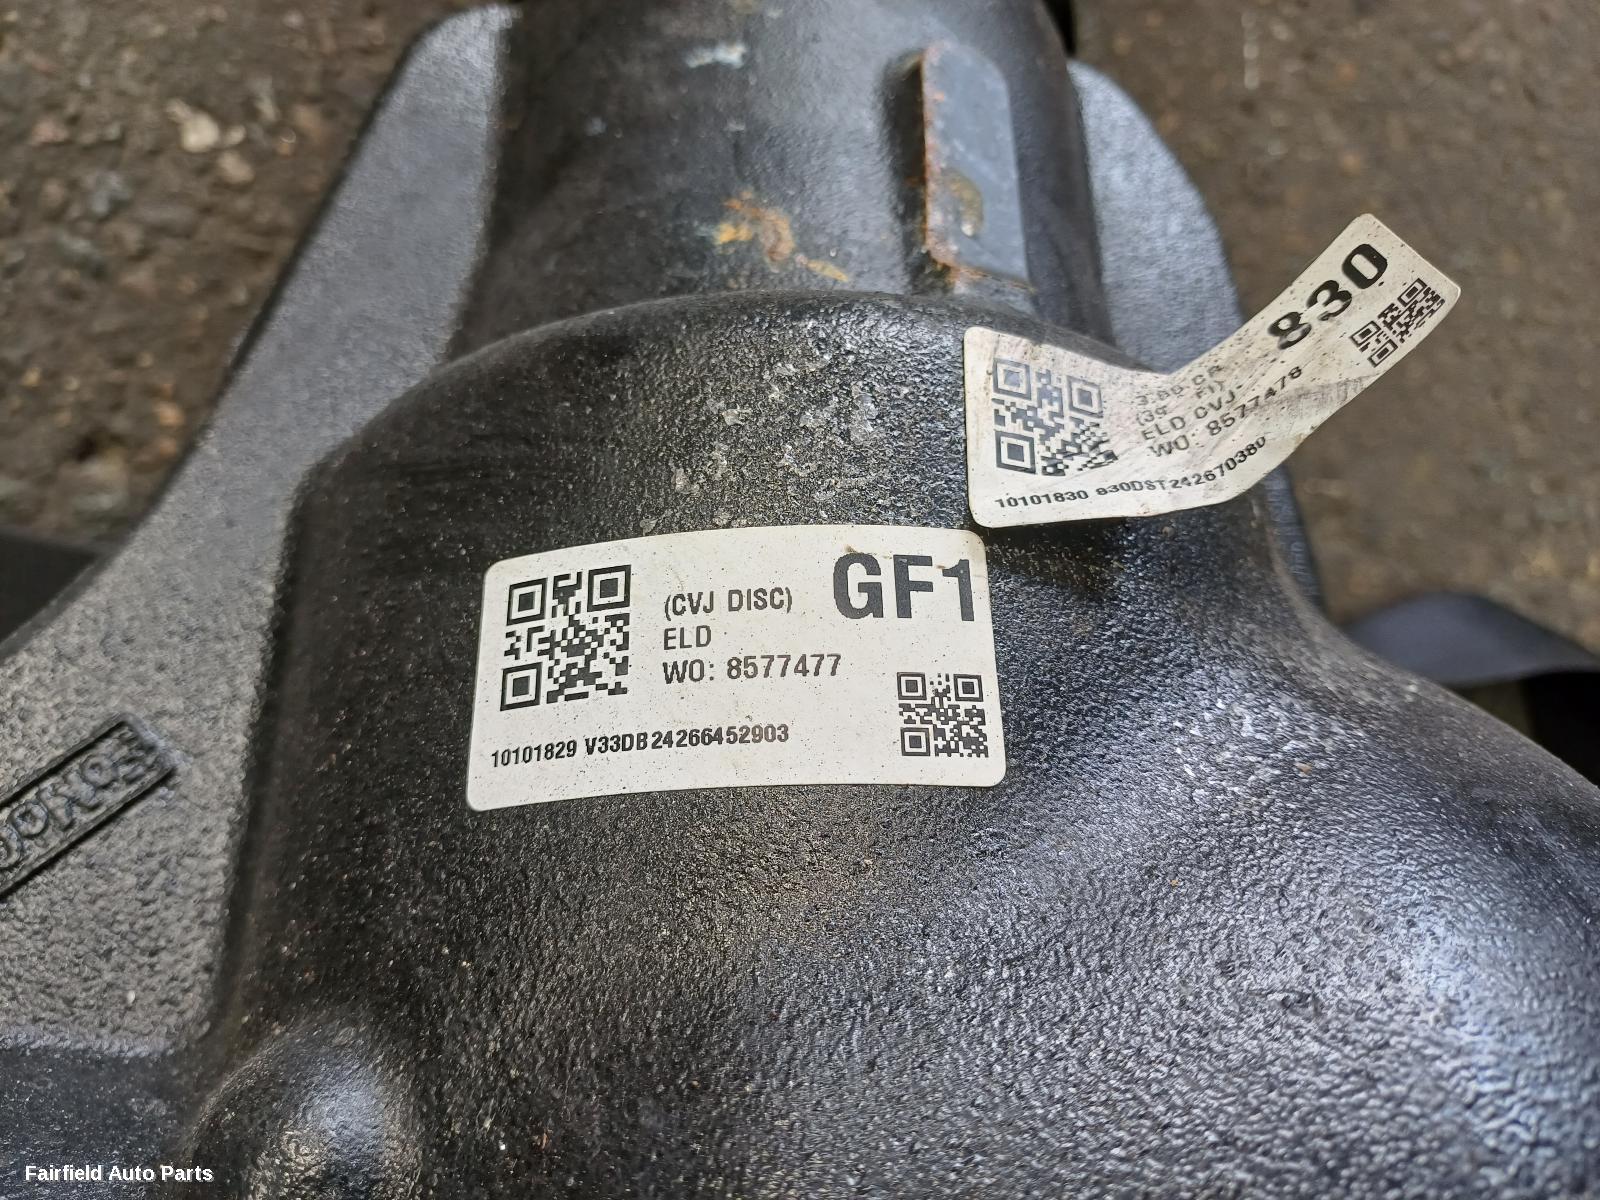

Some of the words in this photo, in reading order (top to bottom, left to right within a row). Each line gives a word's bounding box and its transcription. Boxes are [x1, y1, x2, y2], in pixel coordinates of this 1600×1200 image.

[1268, 242, 1388, 351] 830
[1206, 365, 1303, 437] 8577478
[1141, 415, 1186, 441] ELD
[994, 489, 1090, 509] 10101830
[832, 552, 976, 622] GF1
[664, 594, 714, 622] (CVJ
[728, 586, 793, 614] DISC)
[663, 624, 712, 651] ELD
[662, 658, 715, 685] WO:
[726, 653, 842, 680] 8577477
[491, 739, 577, 768] 10101829
